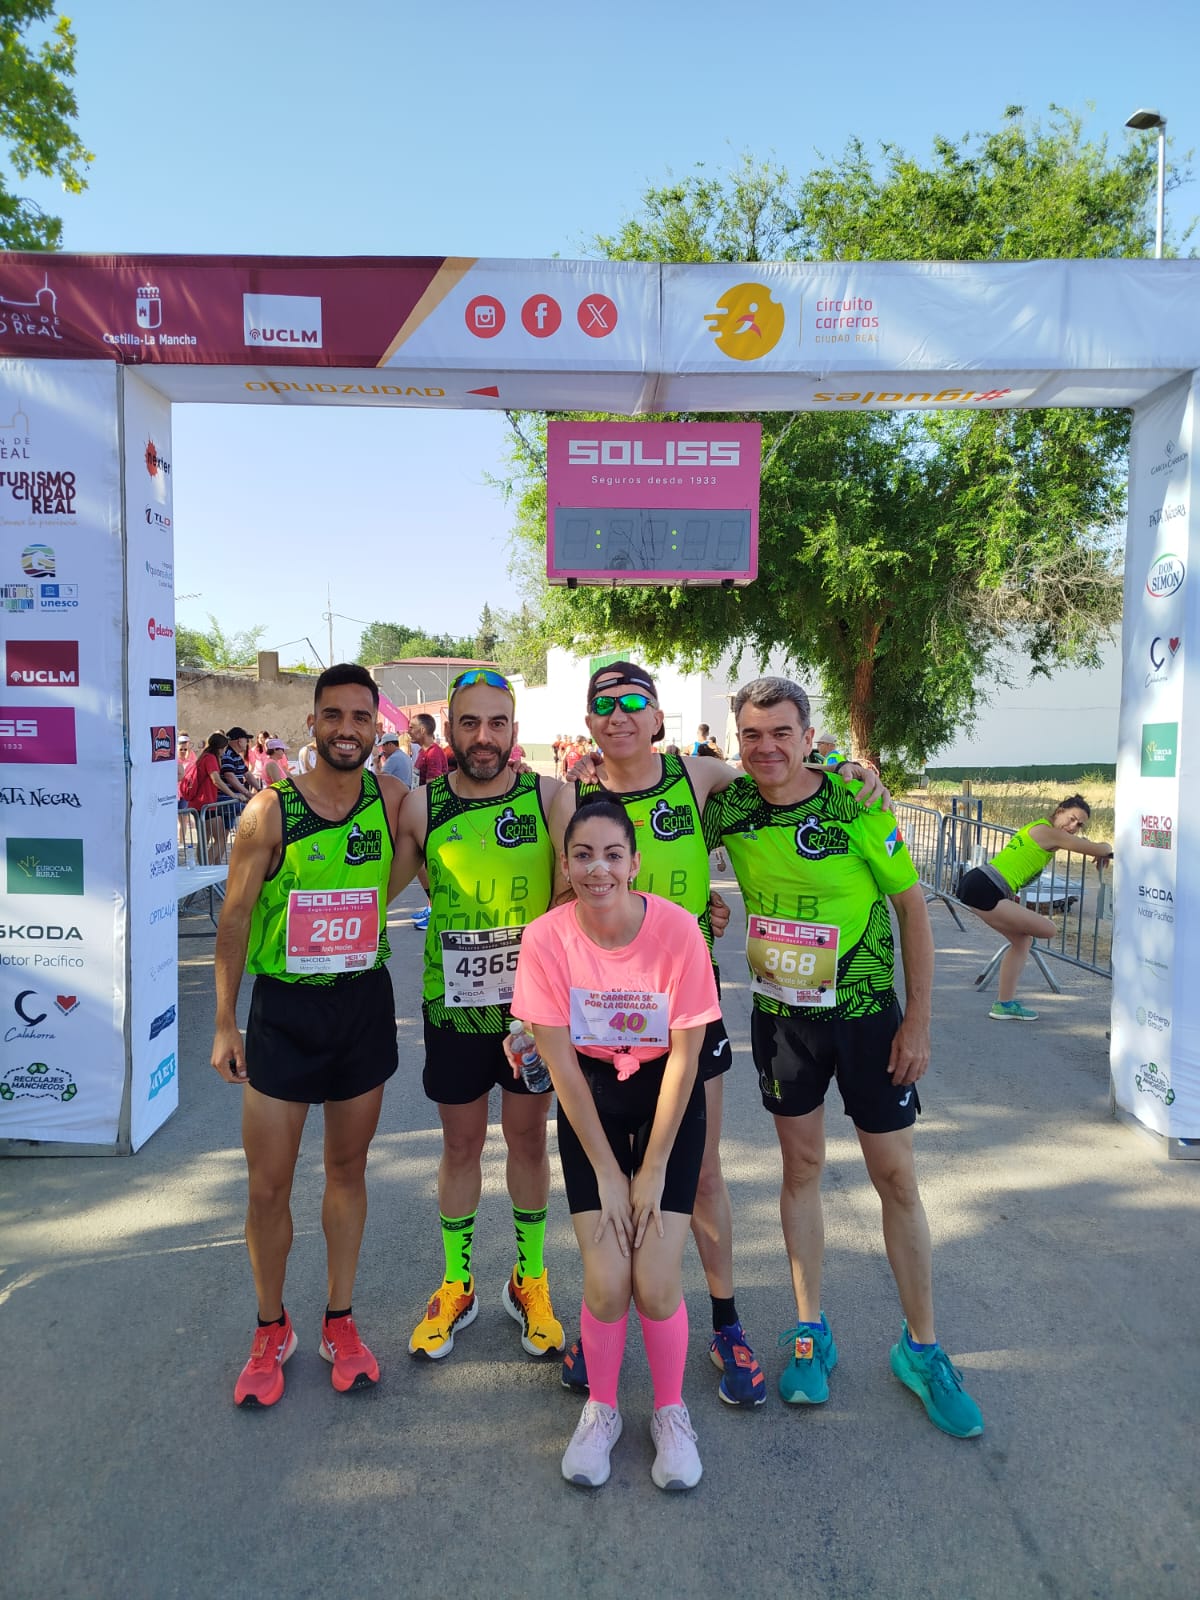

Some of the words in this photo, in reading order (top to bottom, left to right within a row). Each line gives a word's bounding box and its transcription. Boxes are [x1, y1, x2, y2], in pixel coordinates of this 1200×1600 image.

[816, 297, 873, 312] circuito
[13, 321, 63, 339] REAL
[815, 316, 880, 330] carreras
[160, 334, 197, 345] Mancha
[262, 328, 318, 343] UCLM
[815, 334, 850, 344] CIUDAD
[855, 334, 880, 343] REAL
[244, 381, 446, 397] avanzando
[14, 437, 31, 445] DE
[568, 440, 740, 466] SOLISS
[0, 471, 76, 487] TURISMO
[592, 475, 641, 486] Seguros
[648, 476, 683, 485] desde
[690, 476, 717, 485] 1933
[12, 485, 76, 500] CIUDAD
[32, 499, 76, 514] REAL
[1158, 560, 1173, 575] DON
[1151, 570, 1181, 591] SIMON
[22, 670, 75, 683] UCLM
[0, 719, 38, 736] SS
[0, 787, 26, 805] ATA
[29, 788, 82, 808] NEGRA
[297, 893, 373, 907] SOLISS
[310, 917, 362, 943] 260
[448, 928, 522, 945] SOLISS
[756, 920, 831, 942] SOLISS
[0, 953, 30, 966] otor
[34, 953, 84, 967] Pacífico
[456, 951, 520, 978] 4365
[765, 948, 816, 976] 368
[584, 999, 602, 1008] POR
[603, 1001, 614, 1009] LA
[615, 1002, 658, 1010] IGUALDAD
[601, 993, 640, 1002] CARRERA
[609, 1012, 648, 1034] 40
[4, 1027, 57, 1042] Calahorra
[11, 1082, 65, 1090] MANCHEGOS
[13, 1075, 64, 1083] RECICLAJES
